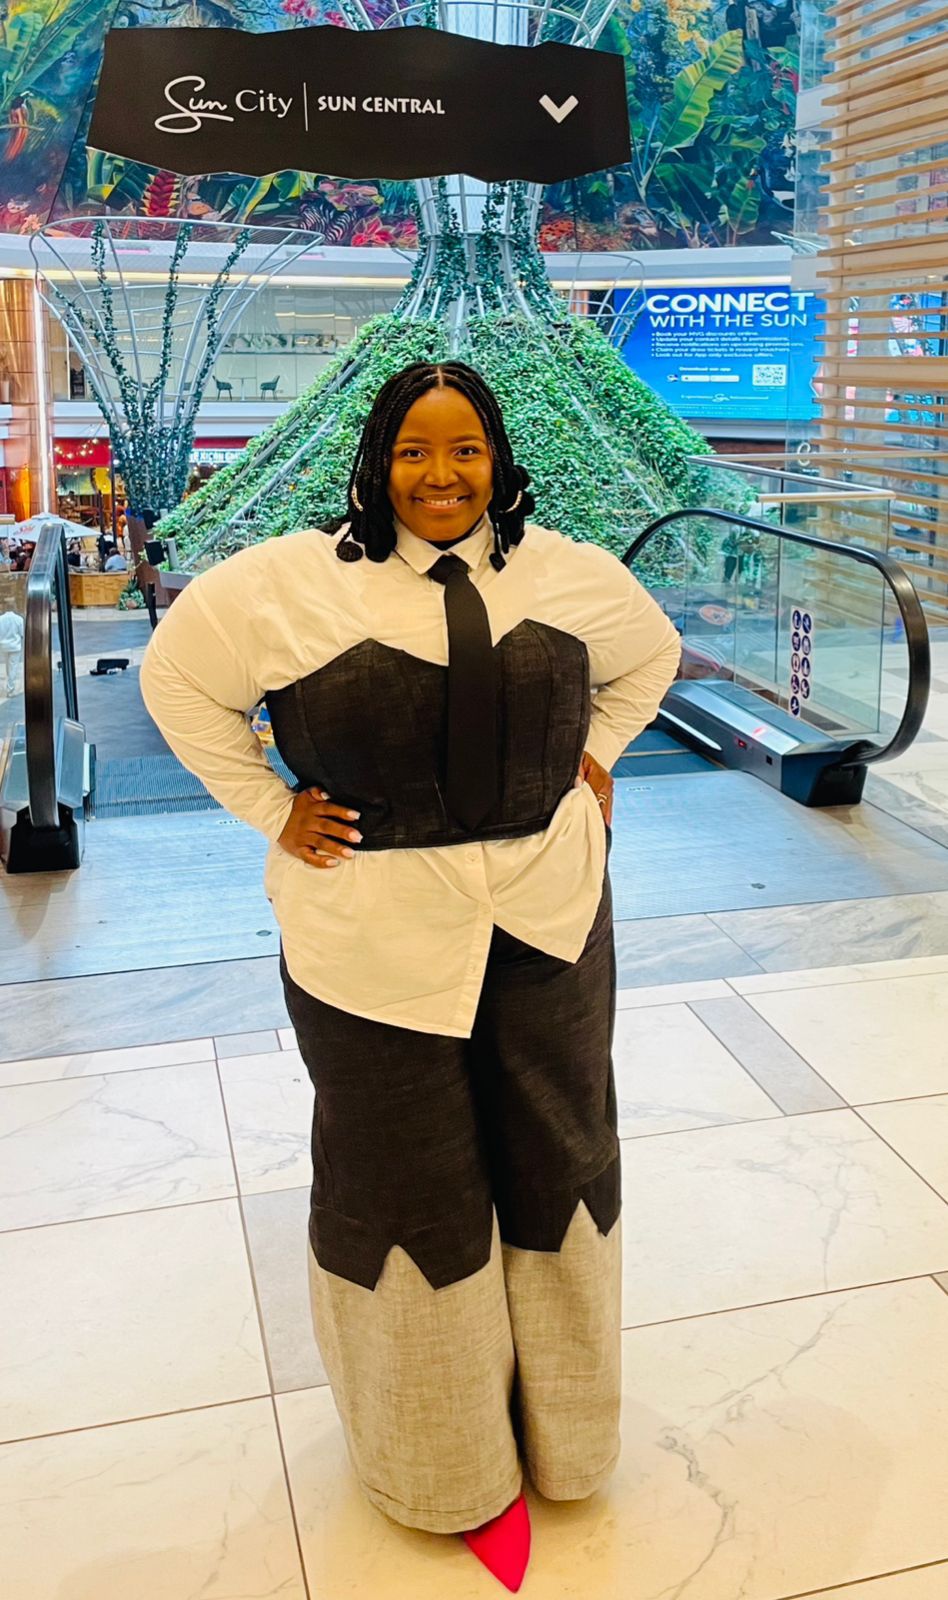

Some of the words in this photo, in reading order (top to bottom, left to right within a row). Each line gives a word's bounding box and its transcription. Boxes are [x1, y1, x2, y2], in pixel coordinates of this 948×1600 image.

[154, 75, 234, 134] Sun
[235, 89, 293, 118] City
[317, 95, 356, 112] SUN
[362, 97, 446, 114] CENTRAL
[647, 293, 814, 313] CONNECT
[650, 315, 704, 328] WITH
[711, 315, 754, 327] THE
[761, 314, 807, 326] SUN
